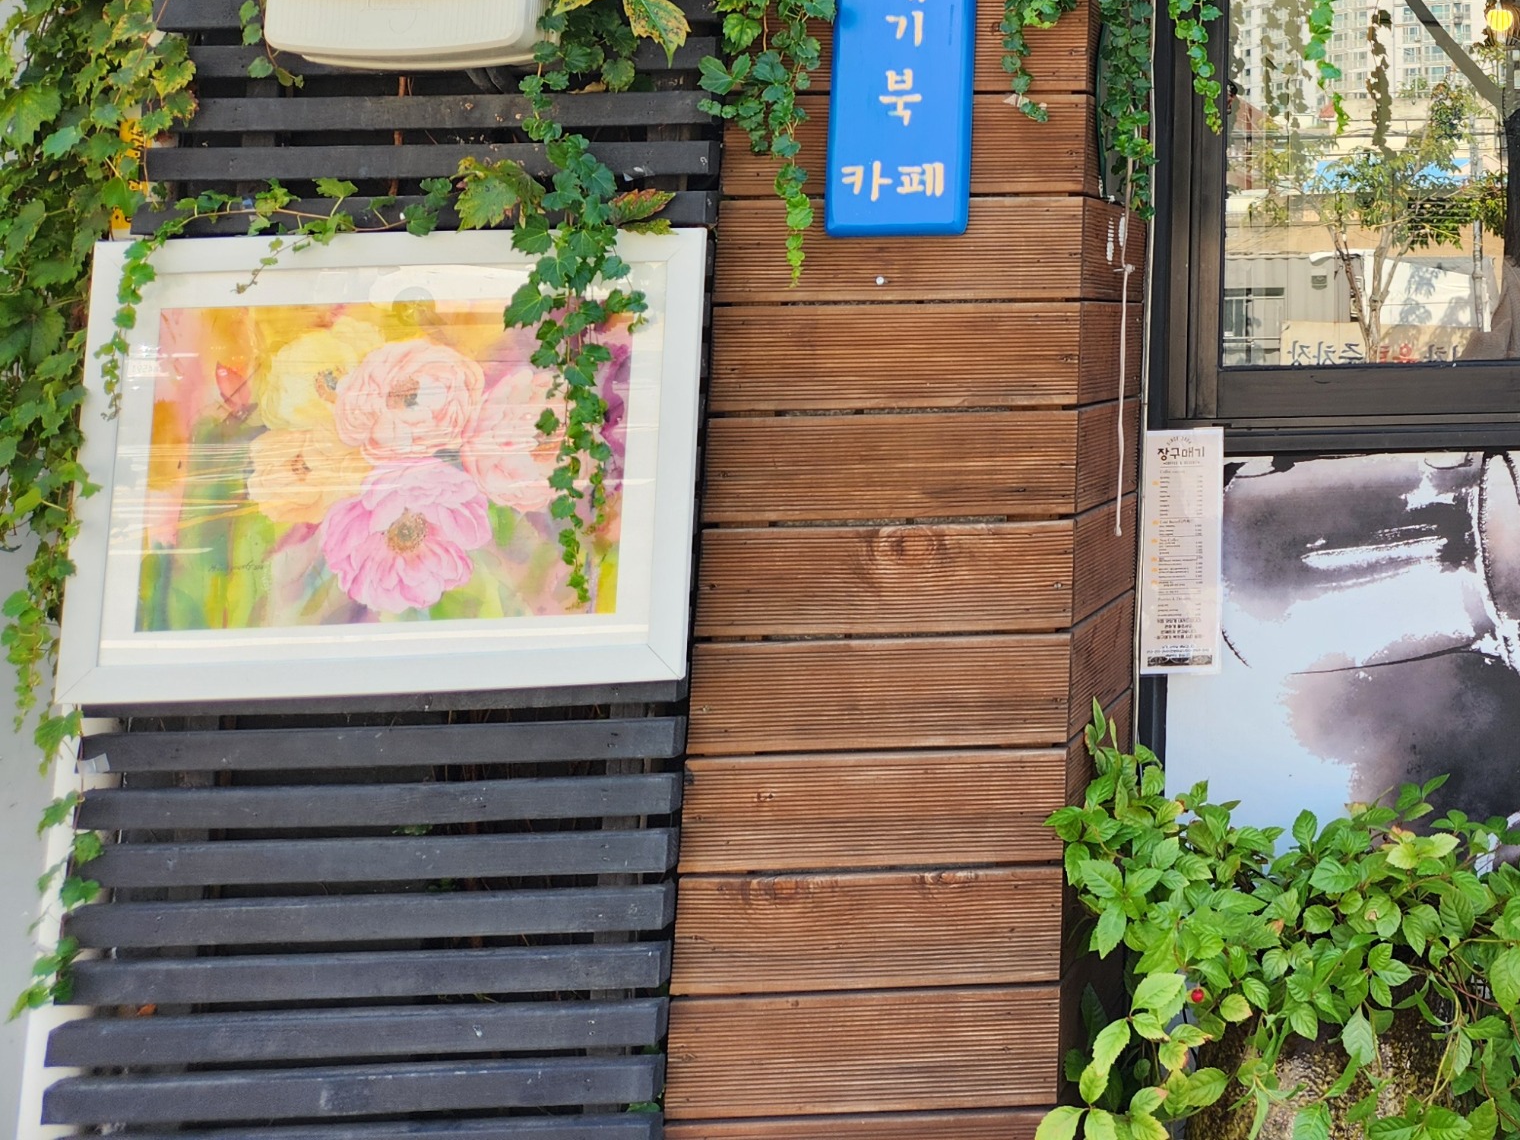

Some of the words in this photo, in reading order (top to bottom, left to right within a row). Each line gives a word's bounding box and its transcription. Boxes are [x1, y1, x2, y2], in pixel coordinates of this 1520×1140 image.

[878, 67, 923, 127] 북
[841, 160, 945, 202] 카페
[1157, 446, 1205, 462] 장구매기
